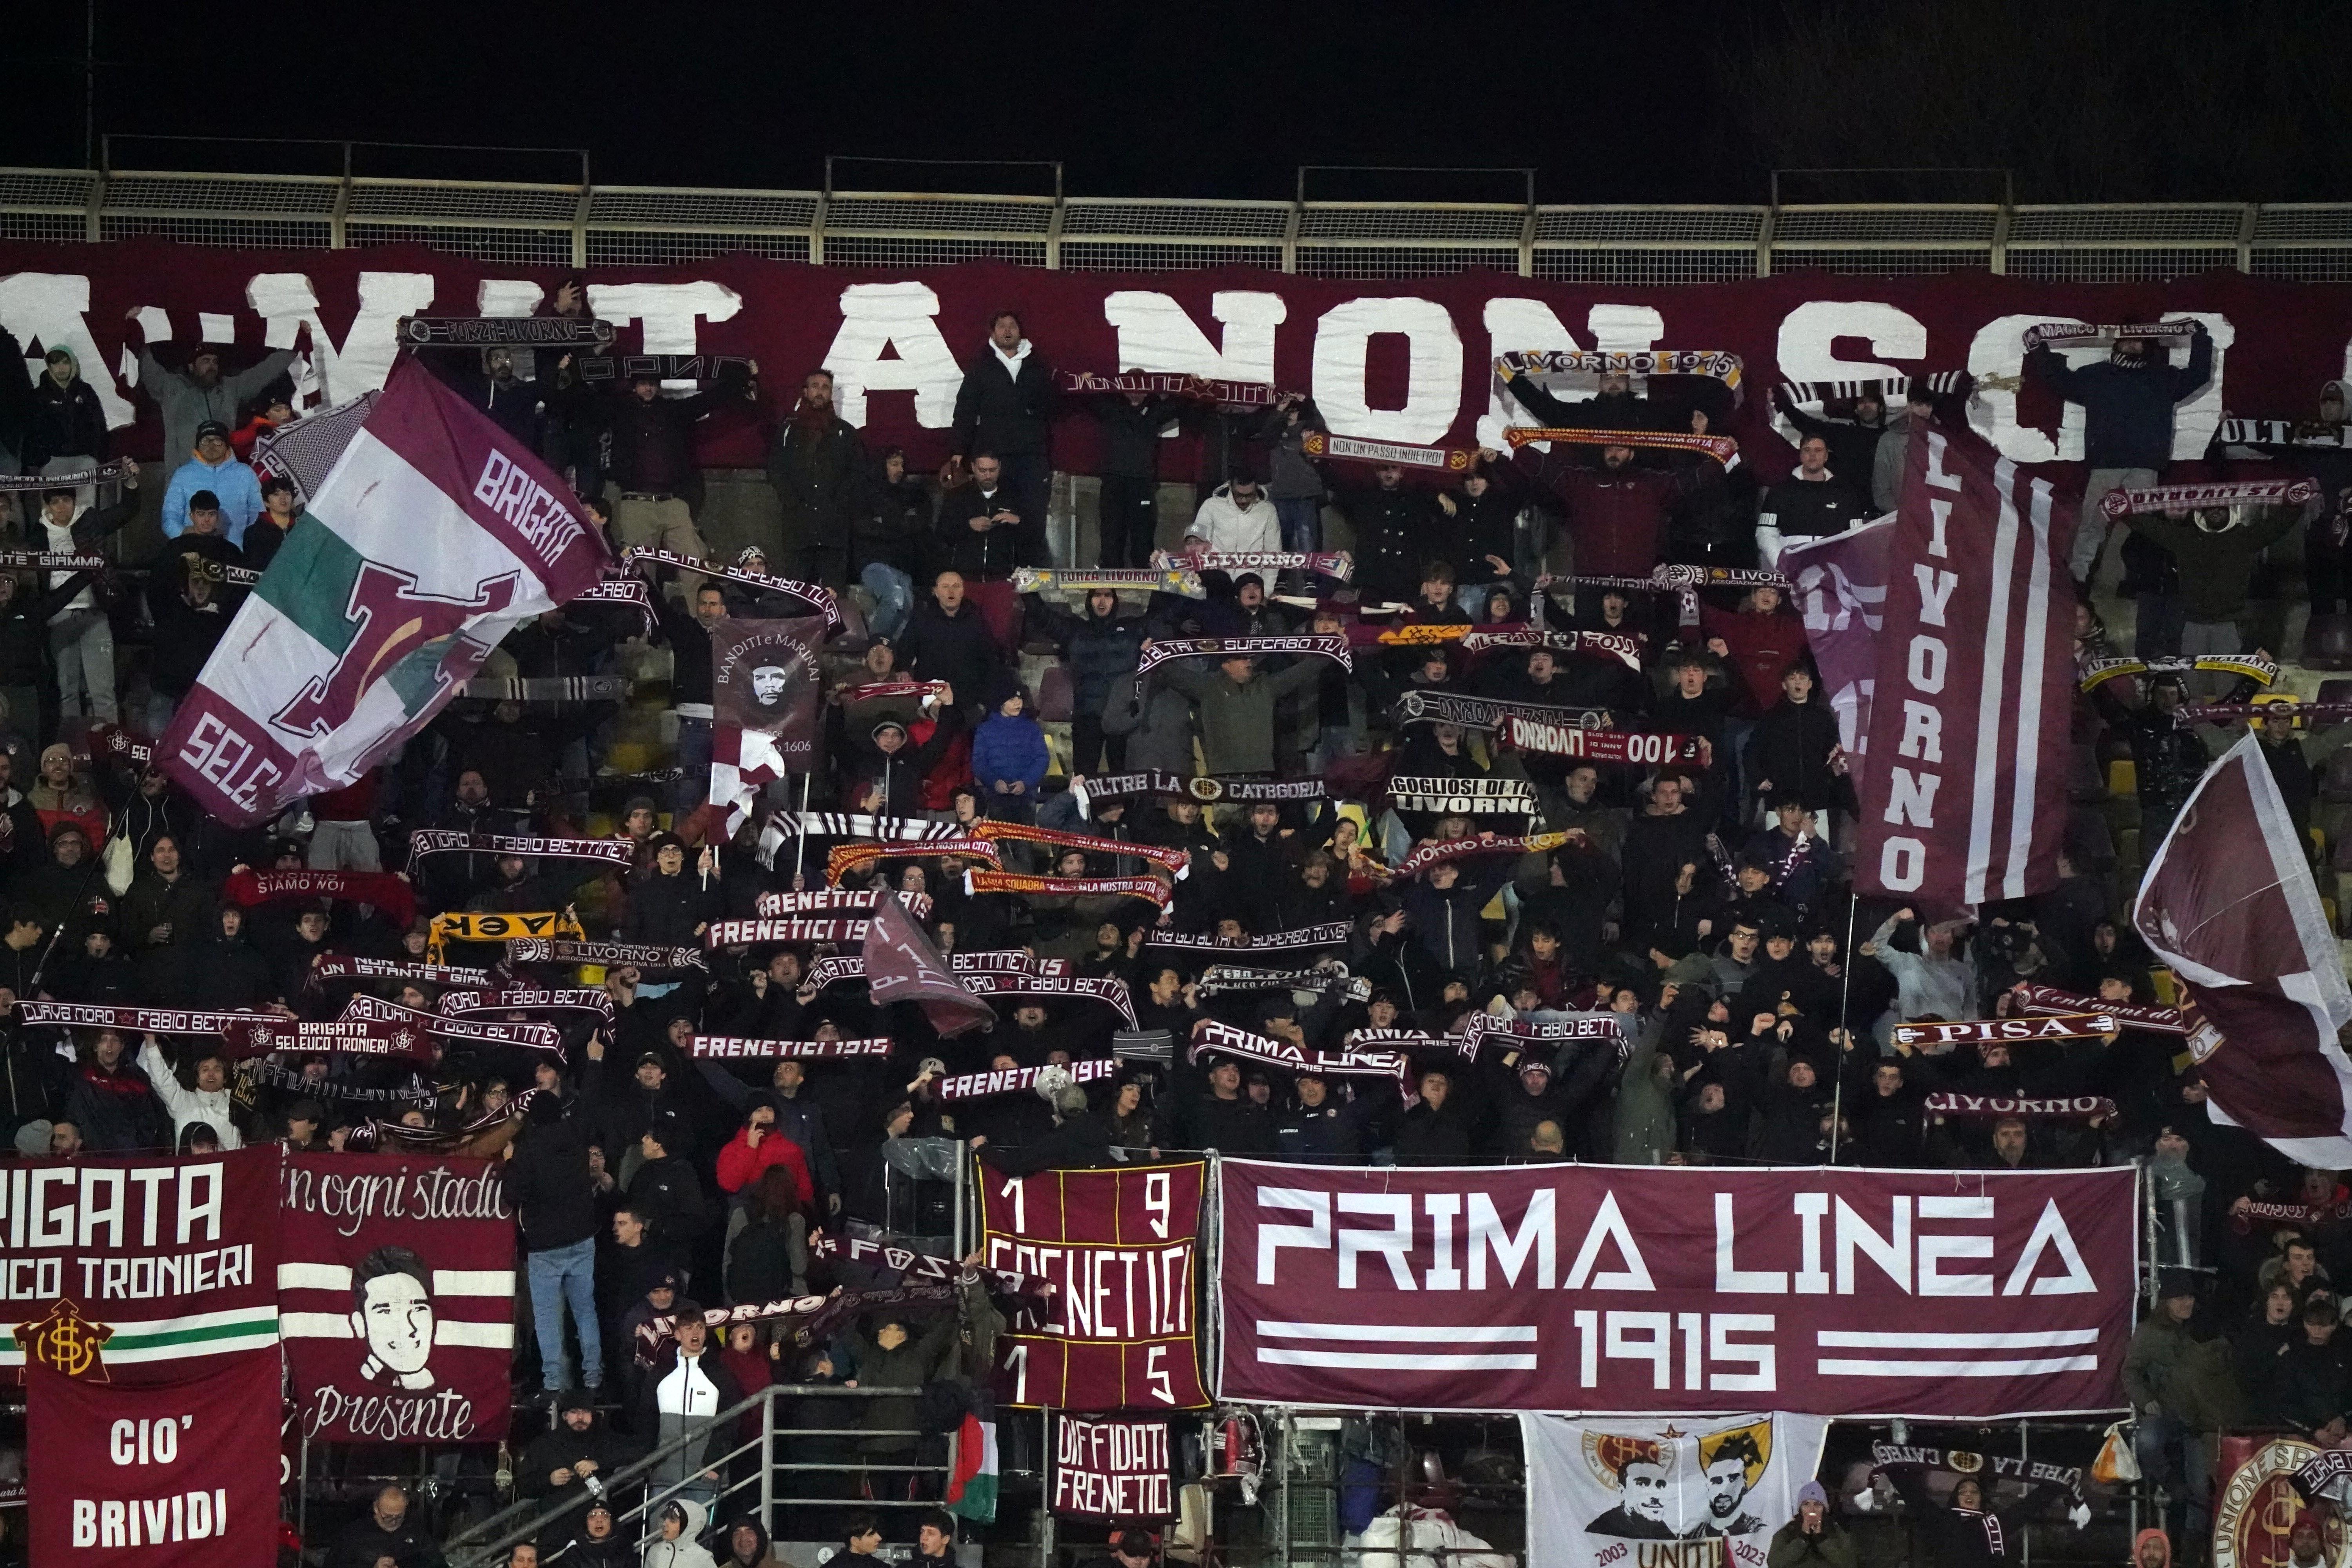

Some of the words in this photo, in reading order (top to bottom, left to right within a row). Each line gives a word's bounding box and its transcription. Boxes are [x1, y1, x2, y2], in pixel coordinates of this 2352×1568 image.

[2040, 324, 2096, 336] MAGICO
[1501, 352, 1656, 372] LIVORNO
[1666, 352, 1735, 374] 1915
[1333, 441, 1351, 453] NON
[1353, 444, 1366, 454] UN
[1368, 445, 1396, 458] PASSO
[1398, 449, 1441, 464] INDIETRO!
[473, 448, 586, 568] BRIGATA
[2132, 488, 2238, 504] LIVORNO
[1202, 554, 1307, 567] LIVORNO
[1061, 571, 1099, 582] FORZA
[1105, 571, 1160, 583] LIVORNO
[1731, 569, 1786, 583] LIVOR
[1224, 639, 1310, 651] SUPERBO
[717, 635, 760, 684] BANDITI
[776, 633, 820, 682] MARINAI
[1880, 431, 1963, 893] LIVORNO
[784, 741, 811, 752] 1606
[1512, 718, 1584, 757] LIVORNO
[1627, 735, 1677, 763] 100
[1084, 773, 1148, 798] OLTRE
[1154, 773, 1183, 793] LA
[1229, 780, 1327, 799] CATEGORIA
[1485, 779, 1506, 795] DI
[1396, 795, 1535, 815] LIVORNO
[493, 835, 544, 851] FABIO
[936, 841, 970, 851] NOSTRA
[257, 879, 310, 894] SIAMO
[316, 879, 345, 892] NOI
[1005, 880, 1045, 891] SQUADRA
[1087, 882, 1098, 892] LA
[1100, 881, 1133, 892] NOSTRA
[710, 919, 837, 949] FRENETICI
[1252, 929, 1310, 947] SUPERBO
[1314, 927, 1327, 941] TU
[555, 955, 610, 964] ASSOCIAZIONE
[577, 946, 660, 962] LIVORNO
[321, 964, 345, 976] UN
[355, 965, 437, 980] ISTANTE
[1018, 977, 1070, 991] FABIO
[501, 990, 549, 1005] FABIO
[2033, 985, 2147, 1017] Cent'anni
[2149, 1008, 2178, 1021] di
[21, 1004, 71, 1022] CURVA
[75, 1008, 115, 1024] NORD
[137, 1011, 186, 1029] FABIO
[1480, 1013, 1514, 1034] NORD
[1531, 1021, 1574, 1037] FABIO
[298, 1022, 368, 1036] BRIGATA
[1933, 1019, 2078, 1043] PISA
[276, 1035, 331, 1051] SELEUCO
[335, 1036, 389, 1053] TRONIERI
[693, 1036, 826, 1057] FRENETICI
[835, 1038, 888, 1054] 1915
[1204, 1021, 1305, 1063] PRIMA
[1296, 1062, 1323, 1073] 1915
[321, 1165, 408, 1236] ogni
[1000, 1178, 1025, 1234] 1
[1145, 1172, 1171, 1238] 9
[1257, 1185, 1657, 1292] PRIMA
[1715, 1192, 2100, 1297] LINEA
[77, 1243, 253, 1299] TRONIERI
[1573, 1310, 1777, 1392] 1915
[1004, 1345, 1028, 1404] 1
[1146, 1345, 1176, 1405] 5
[303, 1384, 475, 1441] Presente
[1058, 1414, 1170, 1471] DIFFIDATI
[1055, 1469, 1172, 1514] FRENETICI
[2216, 1455, 2268, 1555] UNIONE
[73, 1488, 226, 1548] BRIVIDI
[1594, 1542, 1628, 1567] 2003
[1735, 1540, 1766, 1566] 2023
